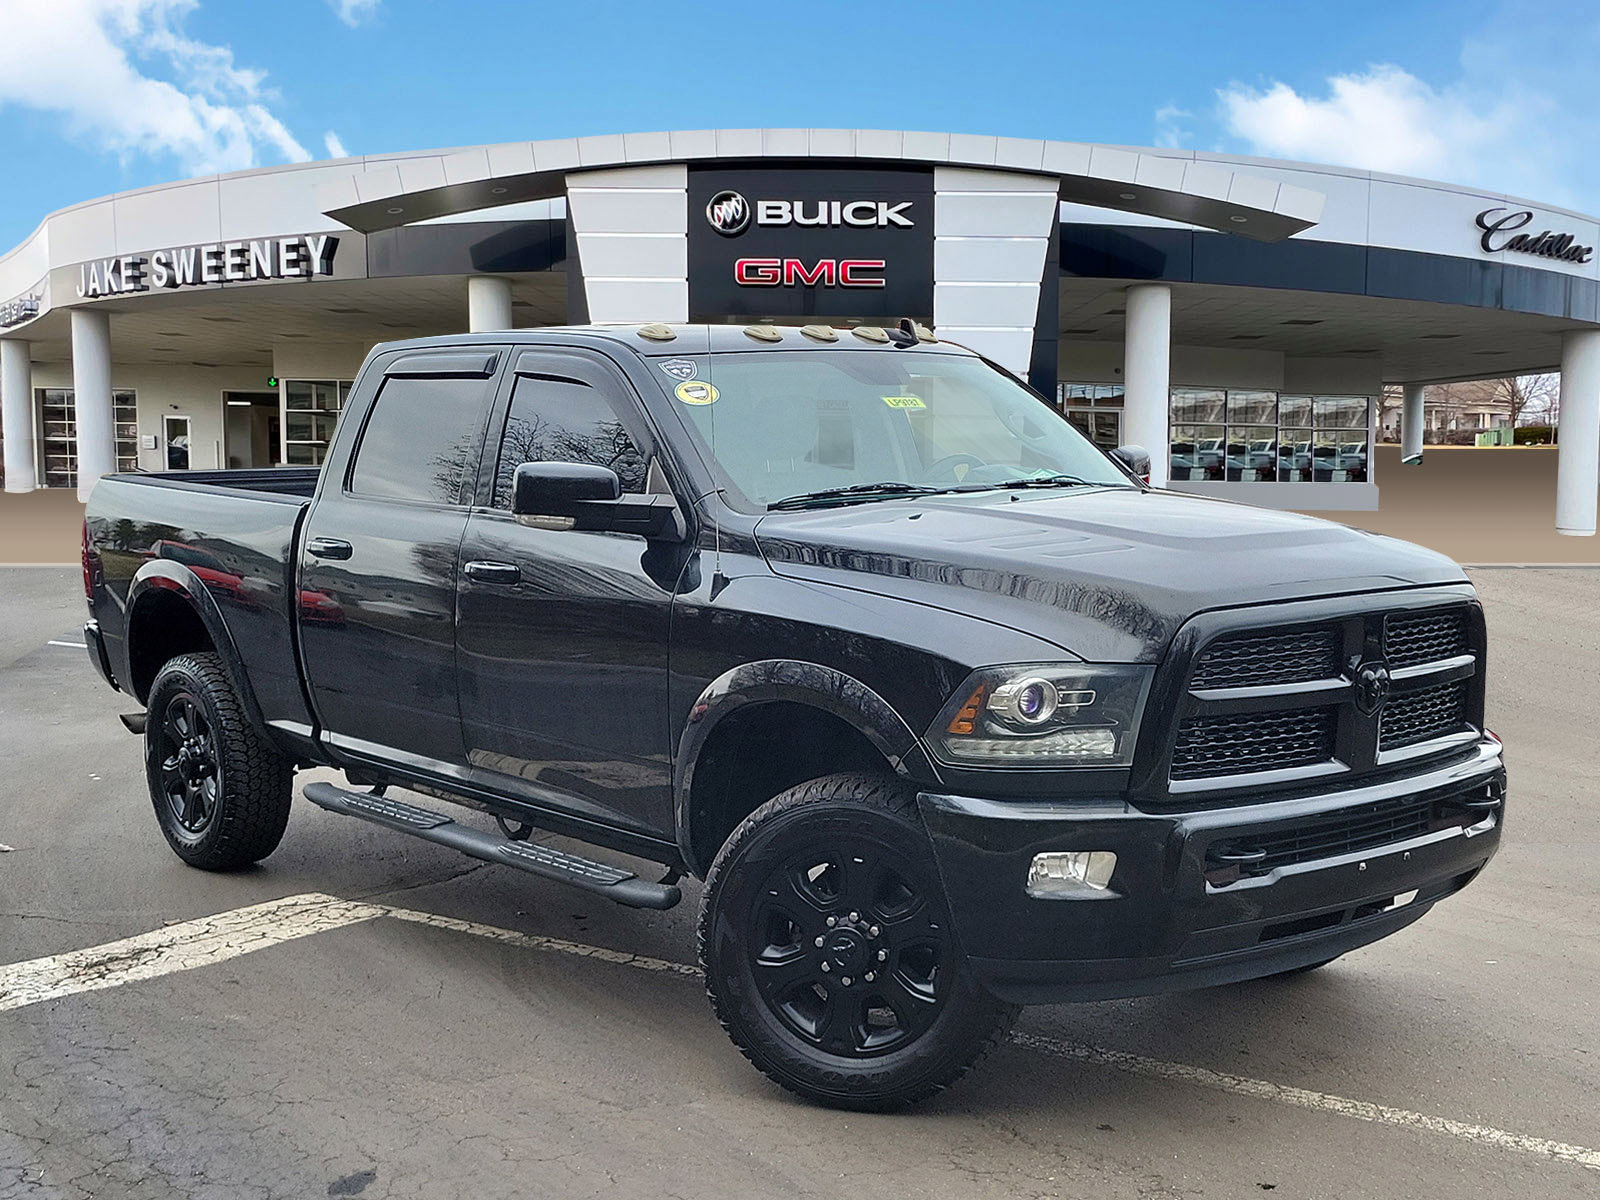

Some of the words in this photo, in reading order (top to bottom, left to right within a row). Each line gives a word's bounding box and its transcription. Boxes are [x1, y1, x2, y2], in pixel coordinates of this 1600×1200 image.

[757, 200, 915, 226] BUICK
[1475, 207, 1593, 264] Cadillac
[76, 255, 146, 298] JAKE
[151, 235, 337, 289] SWEENEY
[734, 258, 886, 287] GMC
